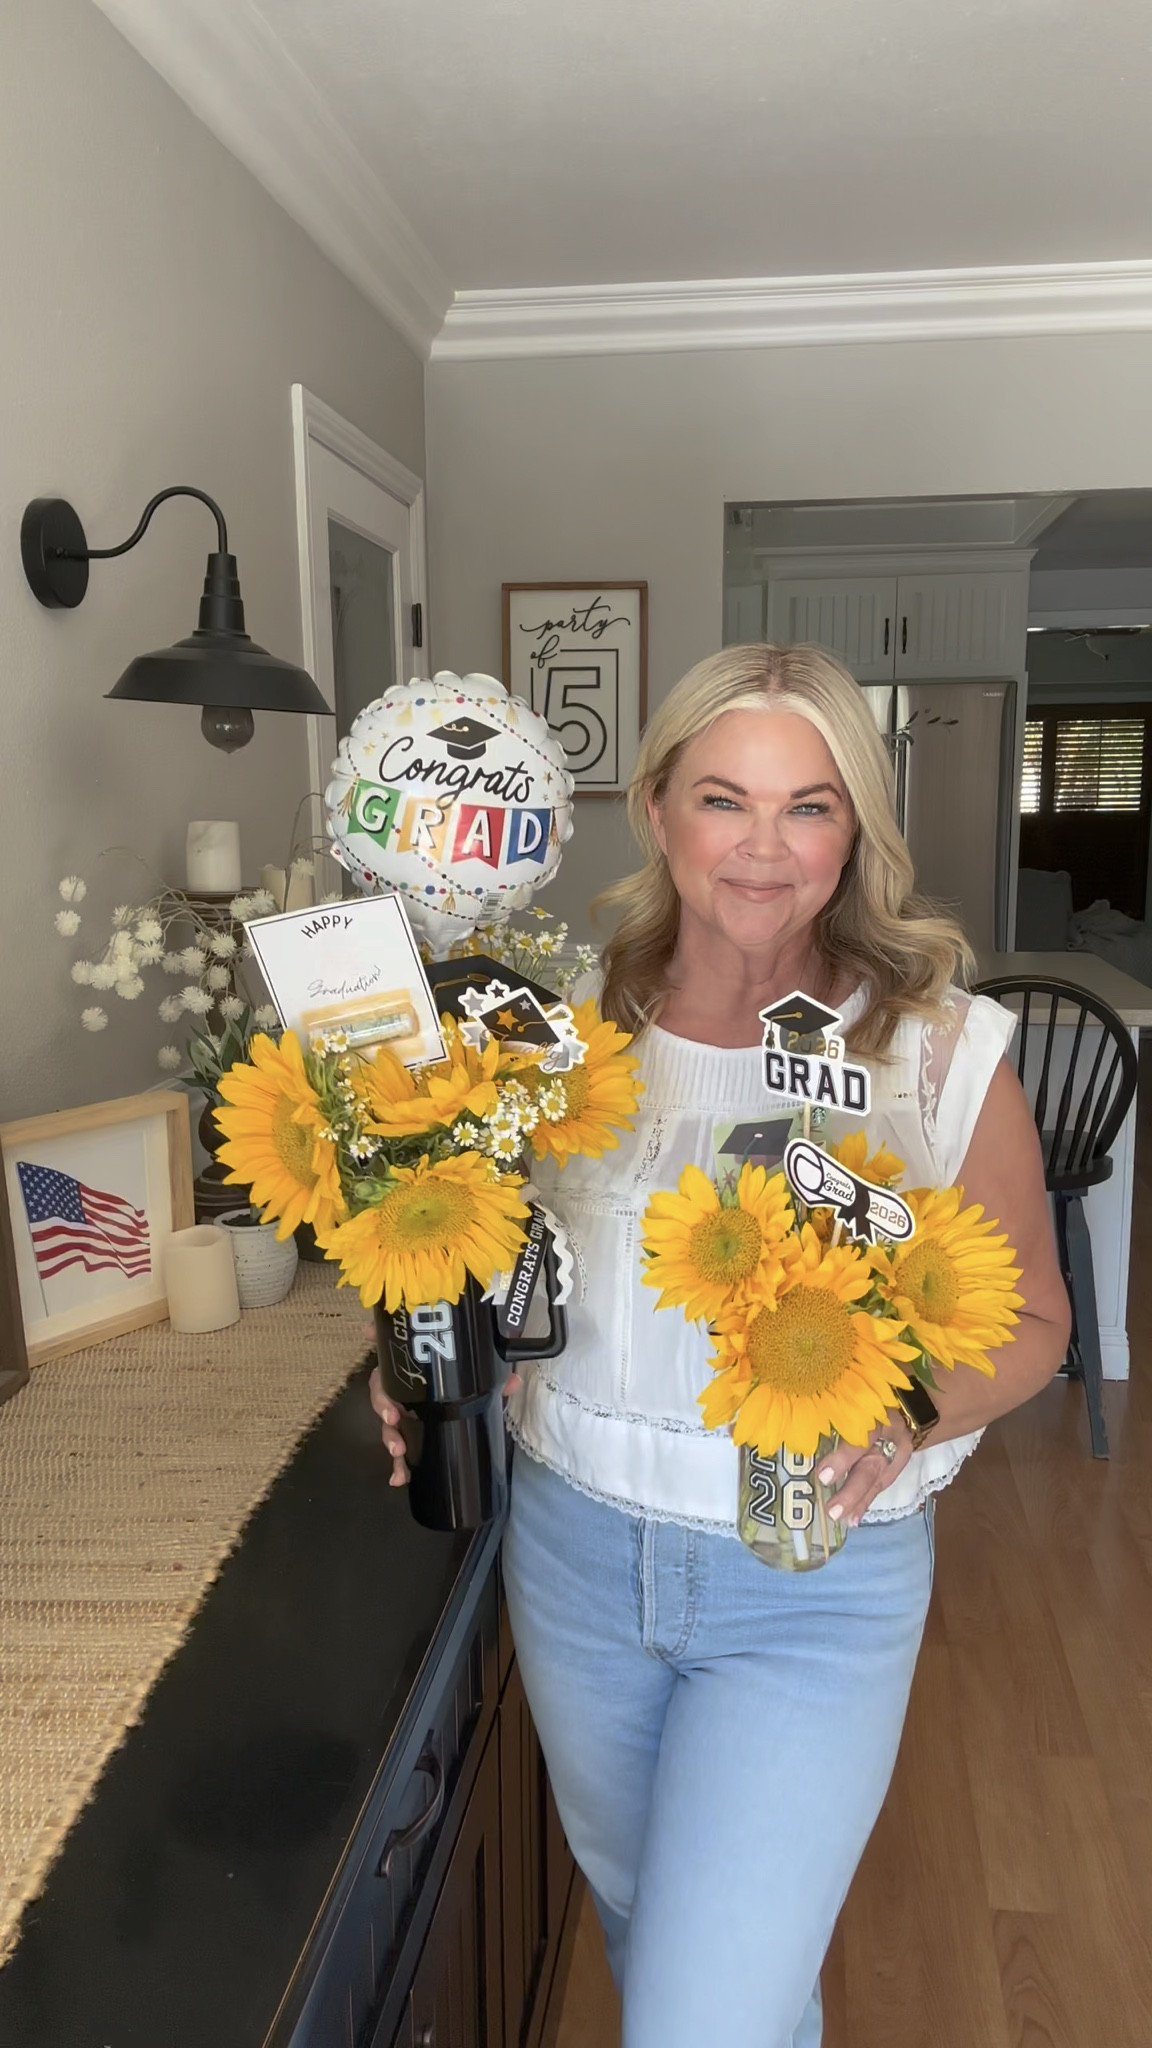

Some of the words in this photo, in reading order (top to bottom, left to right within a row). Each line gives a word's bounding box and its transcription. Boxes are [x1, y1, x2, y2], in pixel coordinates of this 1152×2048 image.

[519, 596, 631, 640] party
[530, 634, 560, 669] of
[544, 666, 608, 774] 5
[378, 735, 535, 811] Congrats
[355, 786, 543, 859] GRAD
[301, 915, 353, 939] HAPPY
[307, 965, 381, 999] Graduation
[786, 1030, 840, 1060] 2026
[764, 1050, 867, 1112] GRAD
[823, 1180, 855, 1202] Grad
[826, 1172, 852, 1191] Congrats
[869, 1201, 907, 1229] 2026
[506, 1241, 540, 1327] CONGRATS
[529, 1209, 546, 1241] GRAD
